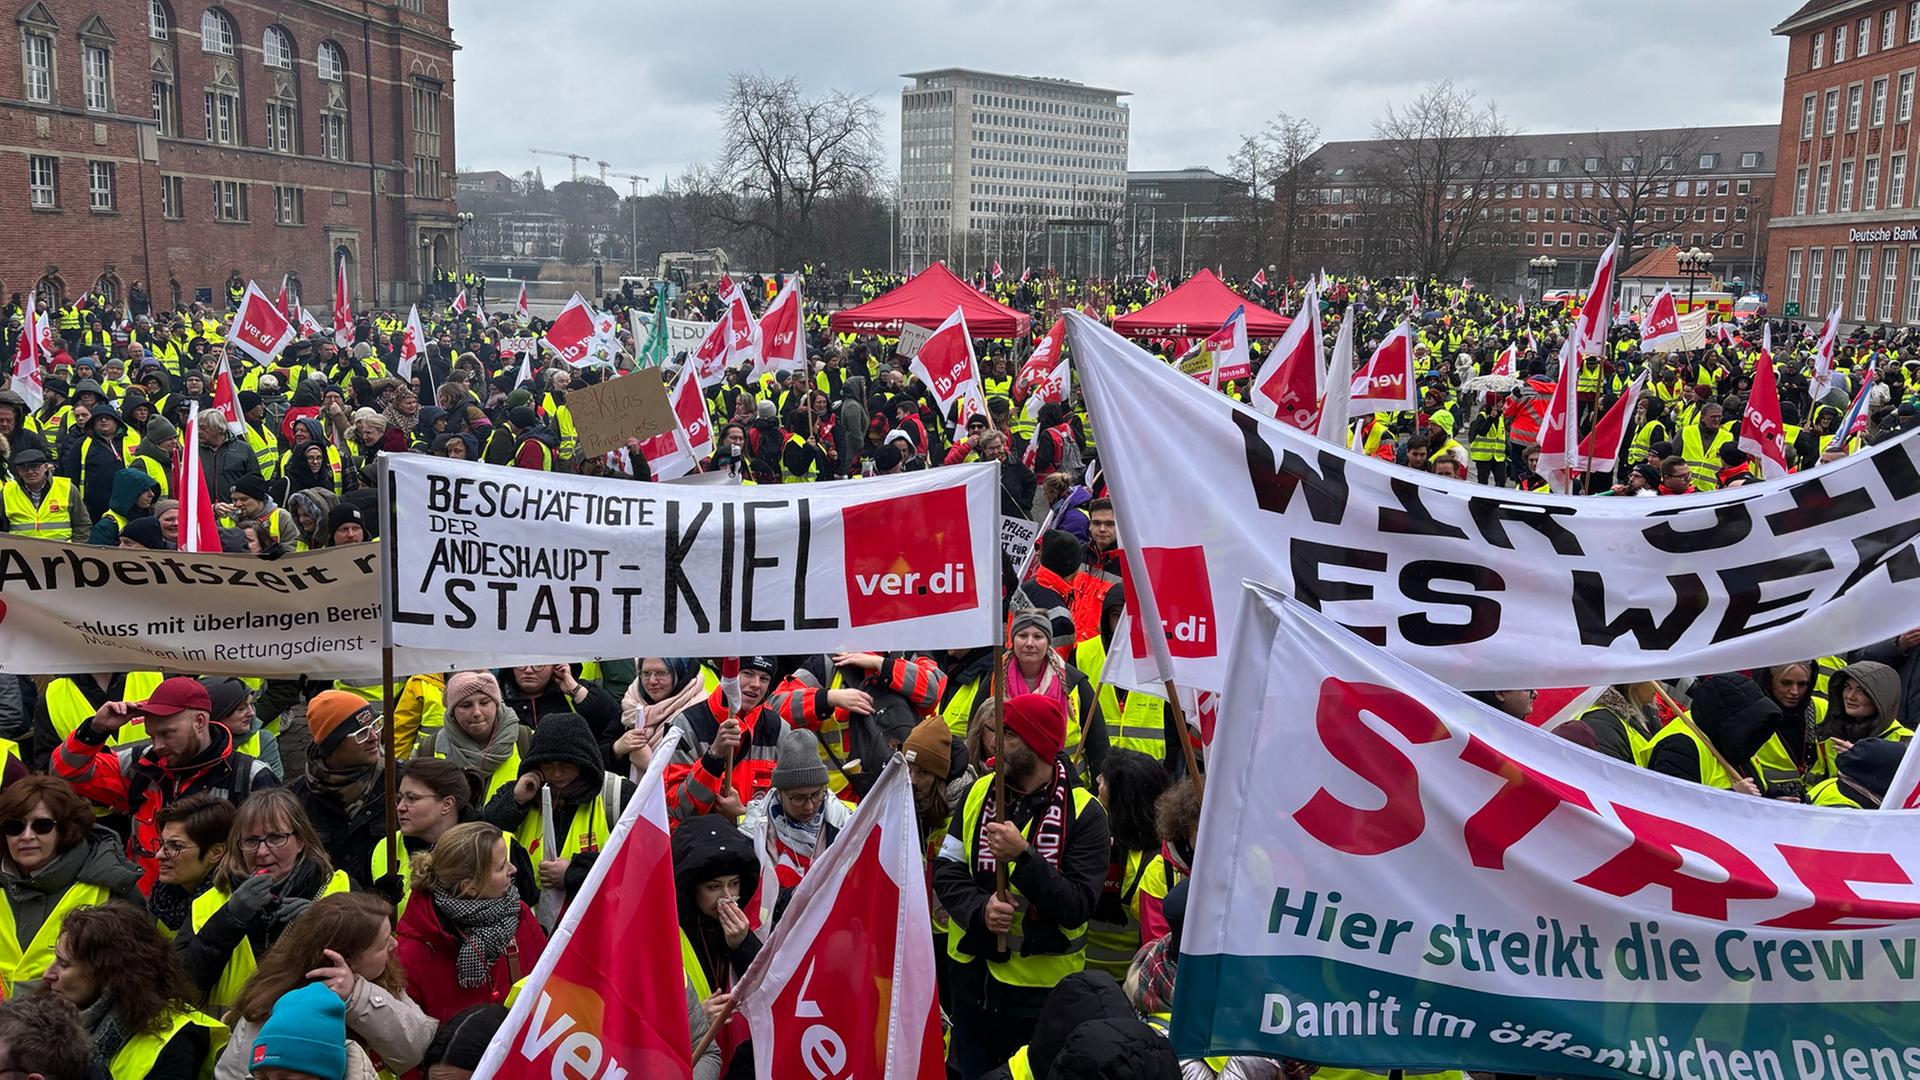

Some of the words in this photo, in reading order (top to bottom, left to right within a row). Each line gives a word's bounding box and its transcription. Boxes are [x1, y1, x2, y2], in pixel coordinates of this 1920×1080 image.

[1849, 227, 1891, 242] Deutsche
[1893, 225, 1919, 241] Bank
[427, 474, 657, 526] BESCHÄFTIGTE
[429, 514, 480, 537] DER
[1002, 519, 1033, 541] PFLEGE
[0, 547, 338, 593] Arbeitszeit
[664, 498, 839, 634] KIEL
[854, 563, 965, 596] ver.di
[444, 578, 642, 635] STADT
[1290, 537, 1507, 647] ES
[147, 616, 185, 635] mit
[192, 608, 320, 632] überlangen
[182, 646, 206, 662] im
[214, 635, 364, 661] Rettungsdienst
[1037, 805, 1062, 870] ALON
[1268, 885, 1414, 955] Hier
[1422, 913, 1603, 981] streikt
[1615, 920, 1702, 981] die
[1715, 929, 1865, 982] Crew
[1259, 989, 1401, 1037] Damit
[1412, 1001, 1478, 1039] im
[1489, 1020, 1785, 1080] öffentlichen
